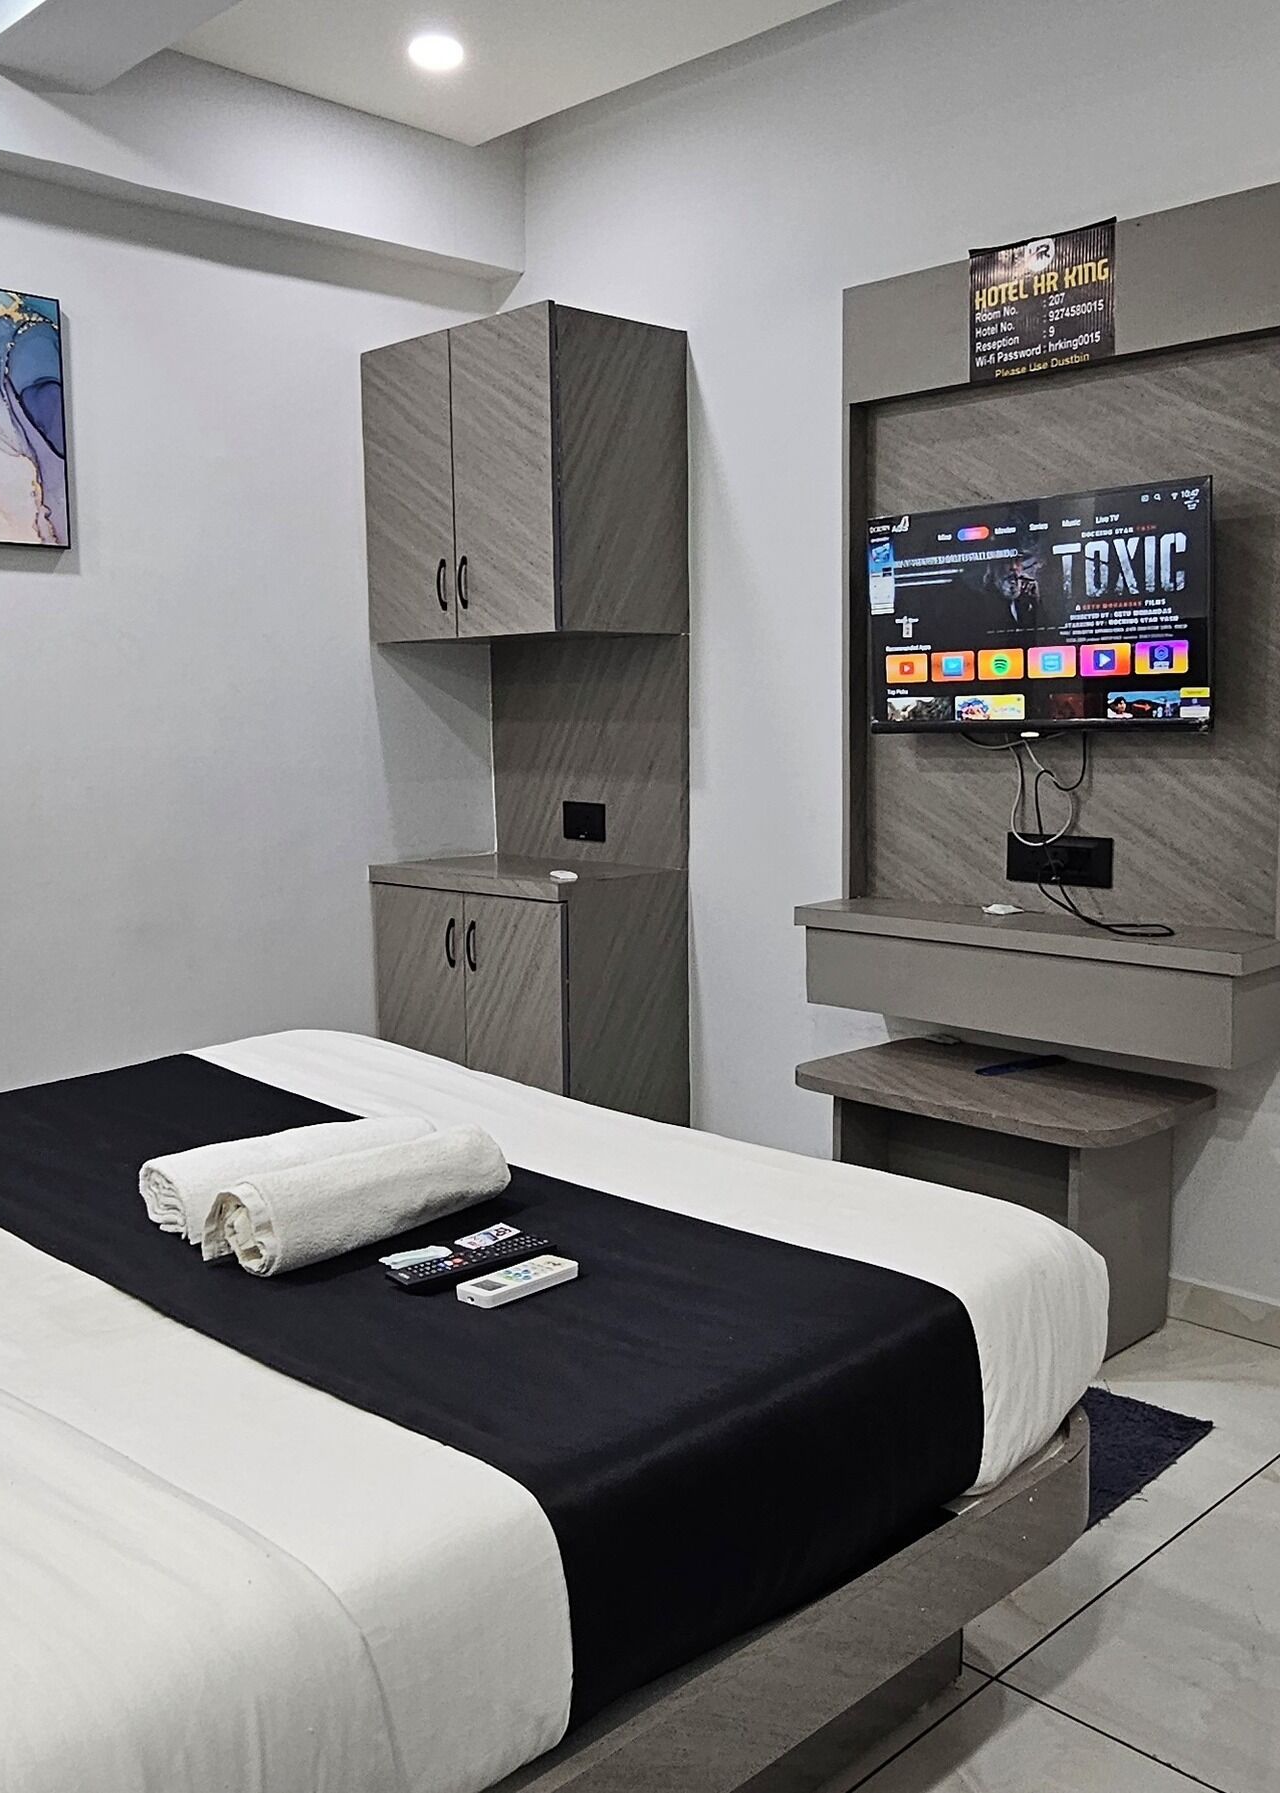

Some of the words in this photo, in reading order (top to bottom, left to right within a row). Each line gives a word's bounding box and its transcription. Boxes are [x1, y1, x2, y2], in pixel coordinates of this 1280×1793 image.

[974, 280, 1029, 310] HOTEL
[1033, 271, 1059, 296] HR
[1064, 258, 1110, 289] KING
[975, 310, 1002, 323] Room
[1003, 306, 1018, 317] No.
[1048, 293, 1065, 307] 207
[975, 324, 998, 338] Hotel
[1000, 321, 1015, 332] No.
[1048, 326, 1055, 337] 9
[975, 354, 996, 368] Wi-fi
[997, 344, 1042, 363] Password
[1048, 331, 1101, 353] hrking0015
[995, 364, 1026, 378] Please
[1029, 360, 1049, 372] Use
[1051, 352, 1090, 368] Dustbin
[1052, 532, 1187, 599] TOXIC
